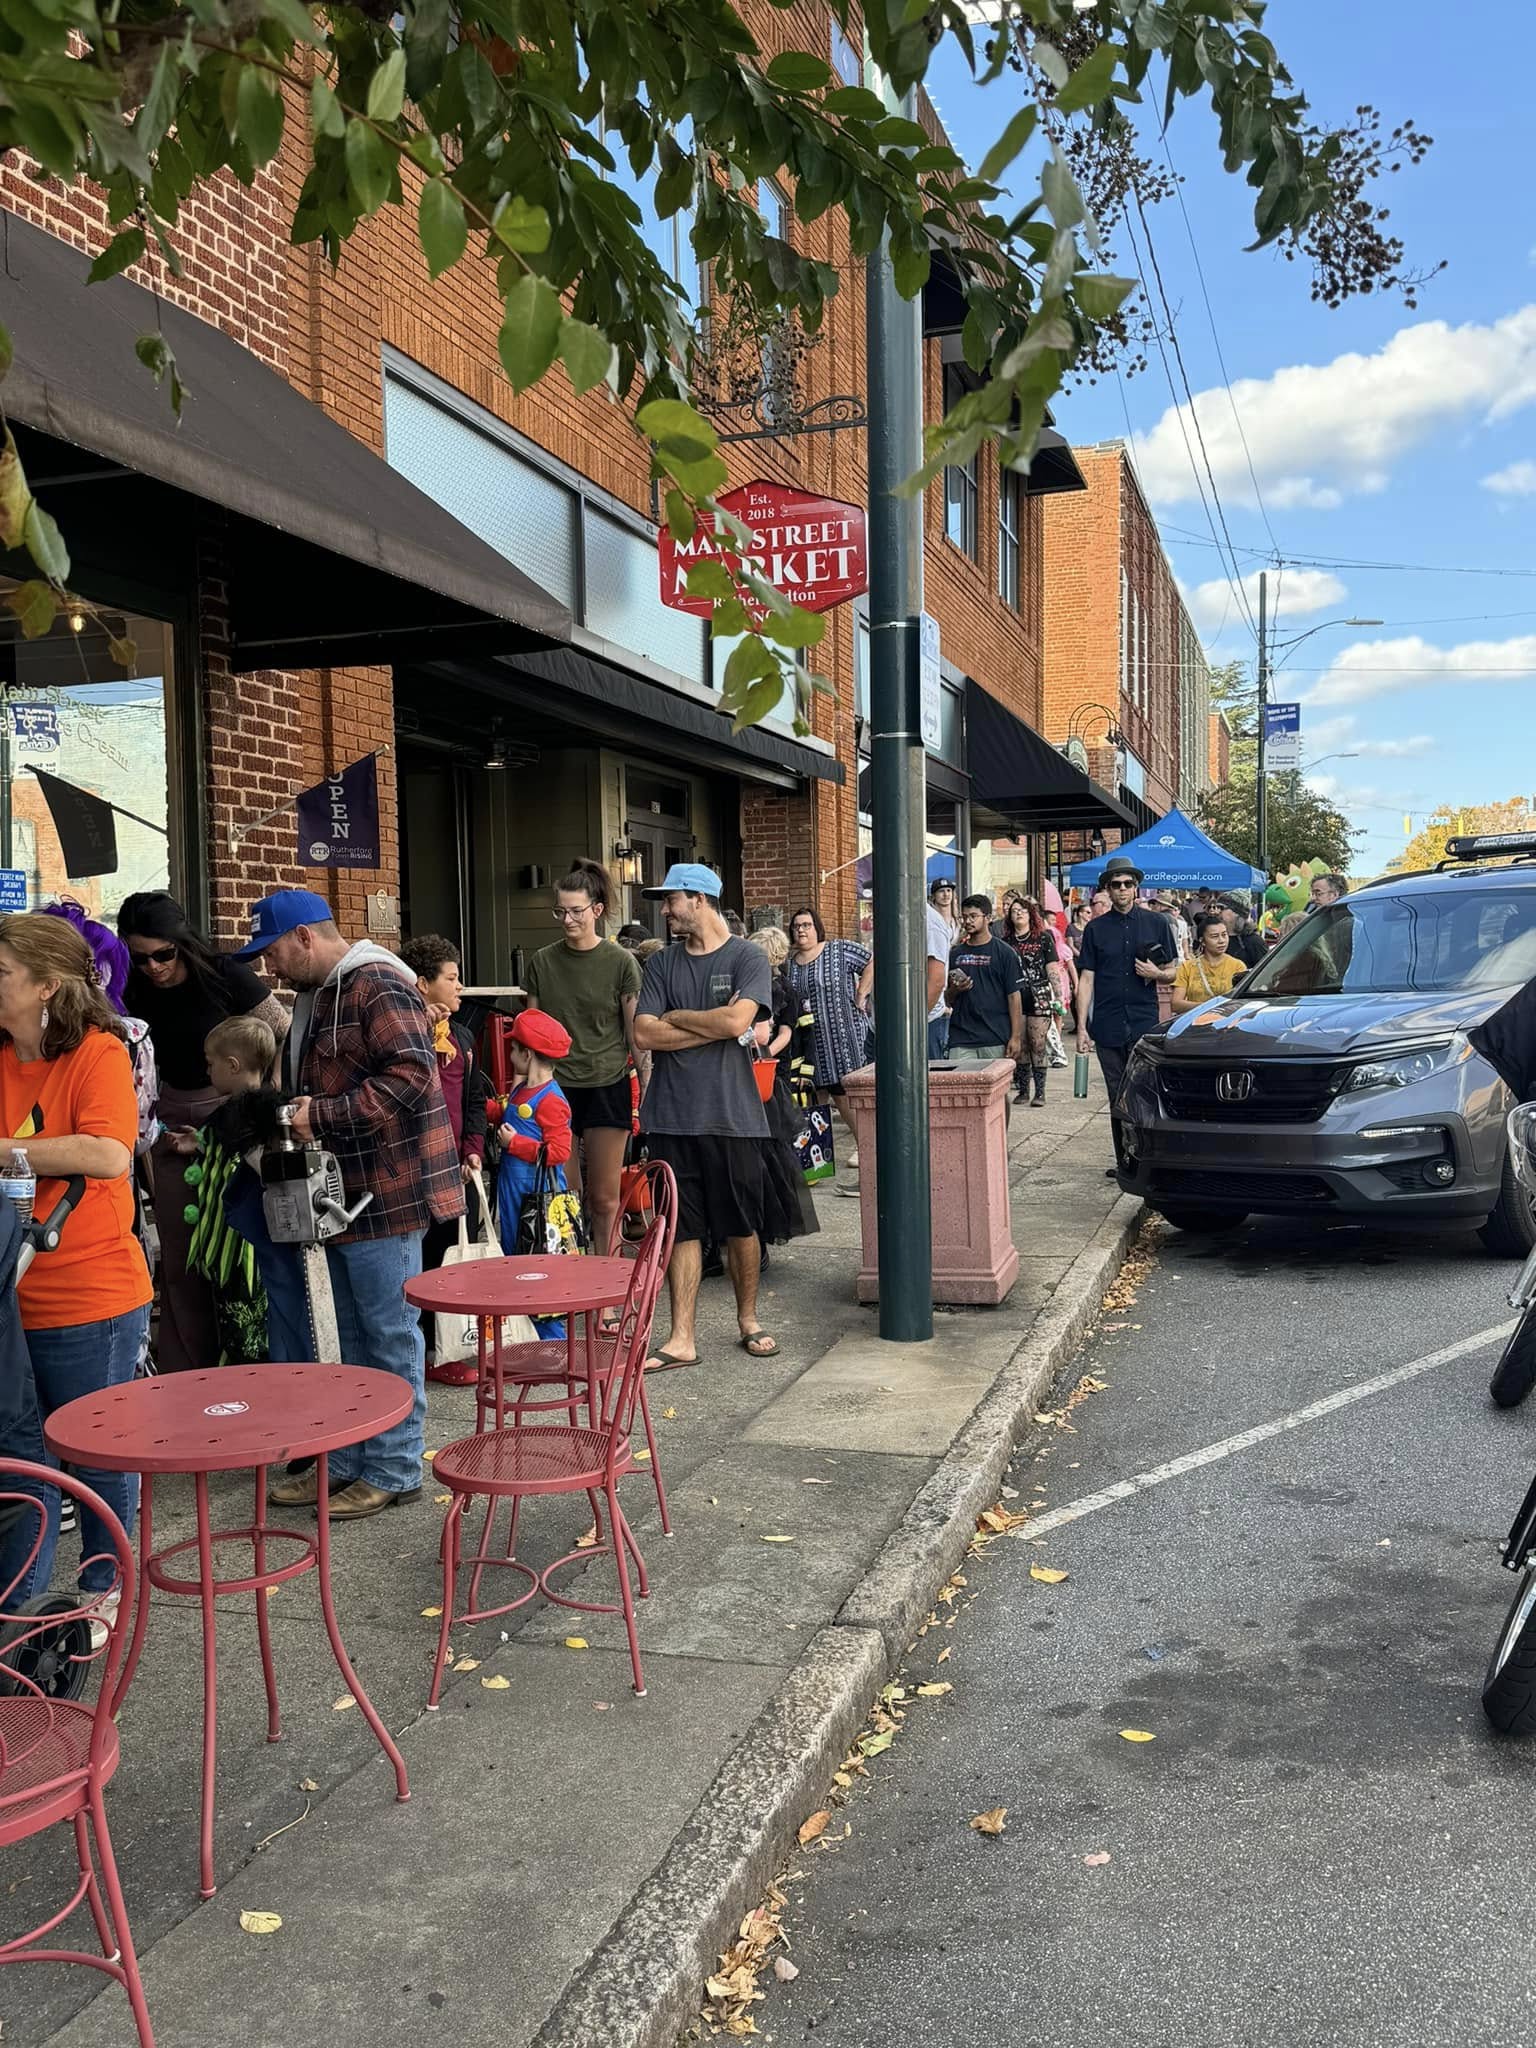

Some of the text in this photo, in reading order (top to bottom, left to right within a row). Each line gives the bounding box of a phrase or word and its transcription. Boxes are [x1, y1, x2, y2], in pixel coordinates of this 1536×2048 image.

[750, 494, 772, 506] Est.
[747, 508, 775, 520] 2018
[751, 520, 855, 550] STREET
[673, 546, 858, 595] RKET
[1143, 871, 1223, 883] ordRegional.com
